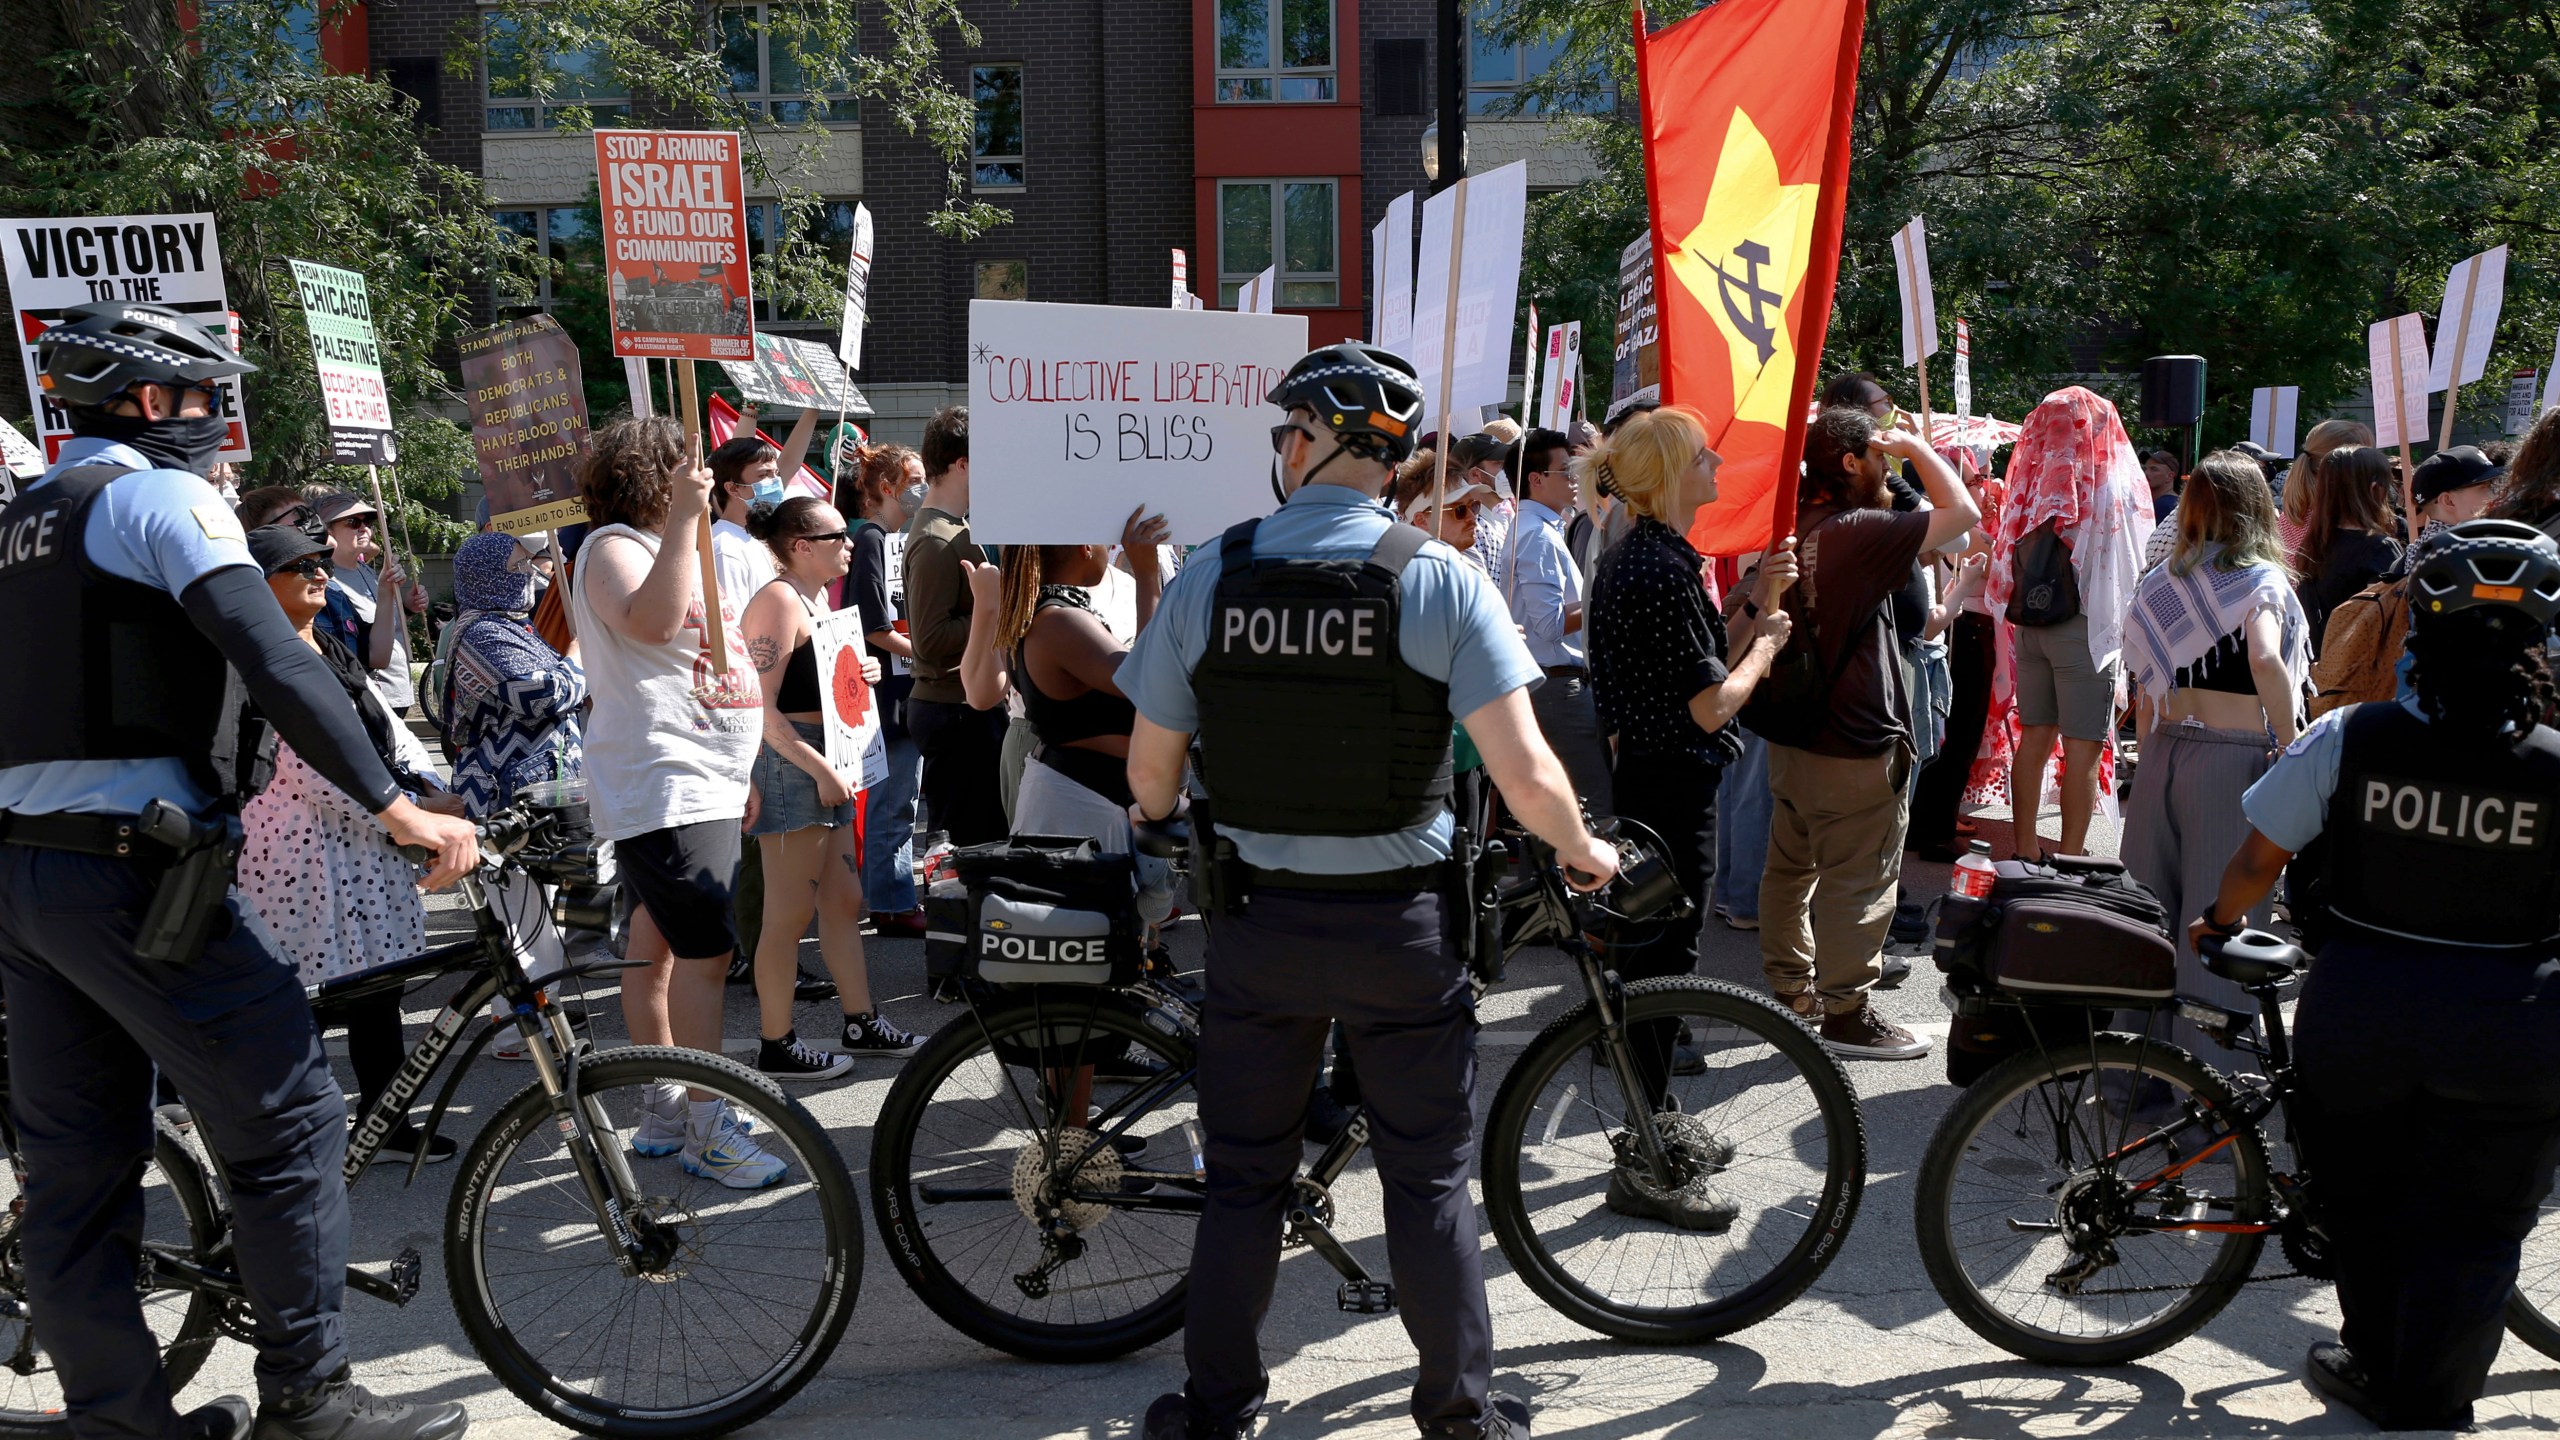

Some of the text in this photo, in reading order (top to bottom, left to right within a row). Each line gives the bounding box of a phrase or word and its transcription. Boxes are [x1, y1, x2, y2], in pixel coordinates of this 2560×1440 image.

[605, 136, 729, 162] STOP ARMING
[609, 162, 733, 210] ISRAEL
[614, 210, 735, 238] & FUND OUR
[17, 222, 205, 278] VICTORY
[616, 239, 737, 264] COMMUNITIES
[294, 263, 320, 281] FROM
[86, 277, 162, 302] TO THE
[300, 281, 369, 321] CHICAGO
[1620, 275, 1653, 312] LEGAC
[123, 310, 178, 331] POLICE
[362, 325, 373, 339] TO
[1618, 318, 1632, 334] THE
[313, 334, 378, 366] PALESTINE
[460, 338, 491, 354] STAND
[492, 331, 514, 346] WITH
[710, 338, 750, 348] SUMMER OF
[1615, 339, 1631, 361] OF
[501, 350, 534, 372] BOTH
[322, 372, 383, 398] OCCUPATION
[478, 368, 567, 402] DEMOCRATS &
[988, 355, 1286, 408] COLLECTIVE LIBERATIO
[328, 397, 388, 422] IS A CRIME!
[485, 393, 570, 426] REPUBLICANS
[481, 415, 582, 452] HAVE BLOOD ON
[1065, 413, 1213, 462] IS BLISS
[495, 453, 530, 473] THEIR
[497, 503, 588, 532] END U.S. AID TO ISRA
[0, 509, 59, 569] LICE
[1223, 607, 1375, 656] POLICE
[2364, 780, 2539, 845] POLICE
[981, 933, 1106, 962] POLICE
[381, 1029, 449, 1113] POLICE
[460, 1118, 522, 1225] BONTRAGER
[885, 1185, 921, 1267] XR3 COMP
[1809, 1182, 1852, 1263] XR3 COMP
[616, 1255, 632, 1266] G2
